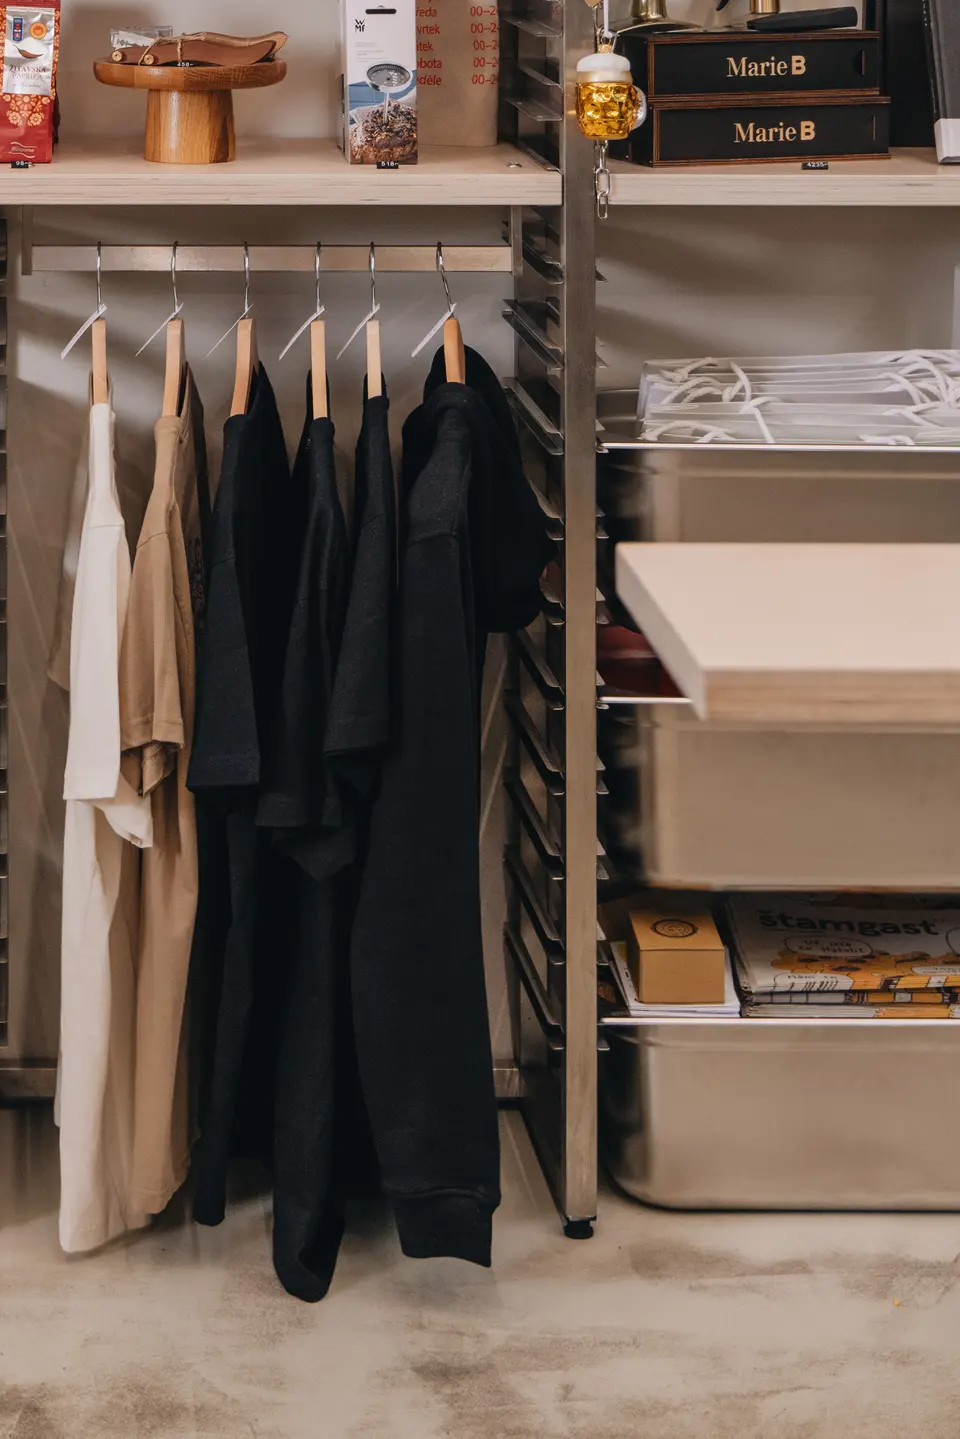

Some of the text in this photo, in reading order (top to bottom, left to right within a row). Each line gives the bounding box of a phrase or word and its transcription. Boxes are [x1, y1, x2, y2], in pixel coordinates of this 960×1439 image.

[416, 58, 442, 69] obota
[727, 55, 807, 77] Marie B
[734, 120, 816, 143] Marie B
